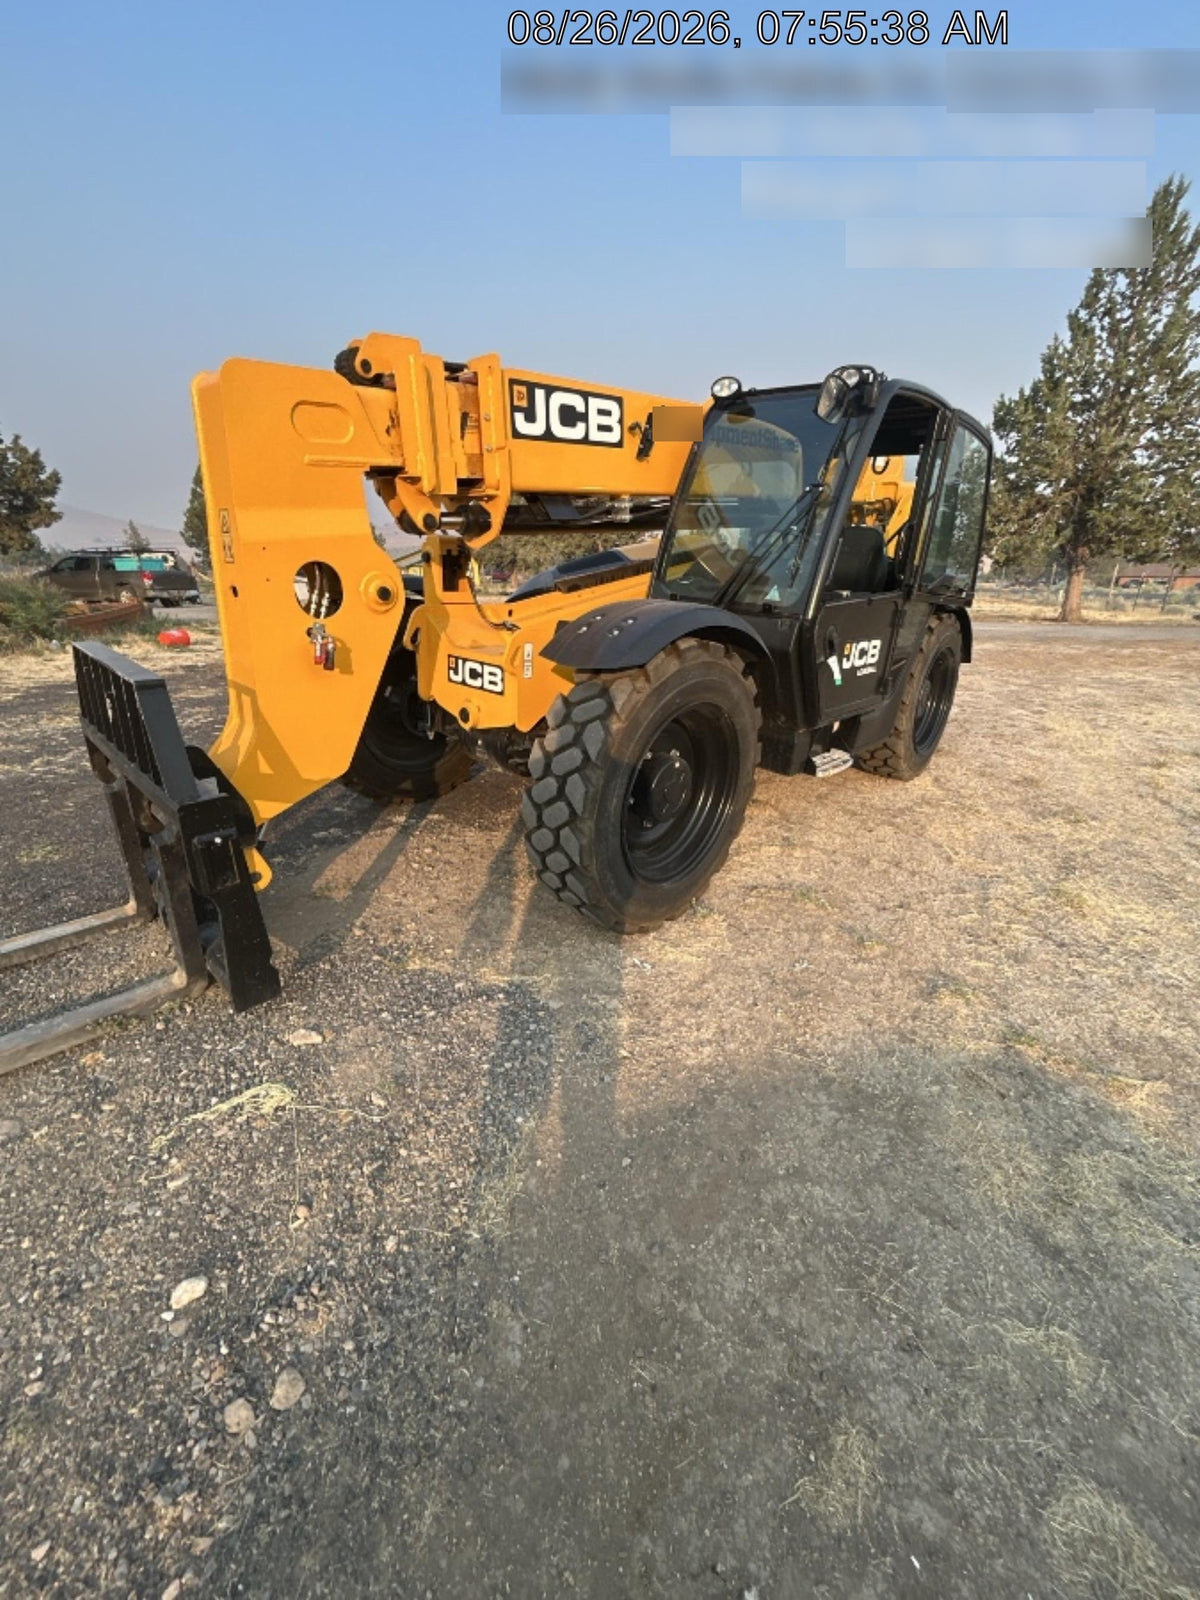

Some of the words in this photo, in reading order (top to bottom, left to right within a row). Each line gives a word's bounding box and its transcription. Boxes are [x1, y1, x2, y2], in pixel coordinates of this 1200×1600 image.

[513, 387, 621, 443] JCB
[842, 639, 882, 669] JCB
[449, 658, 504, 693] JCB
